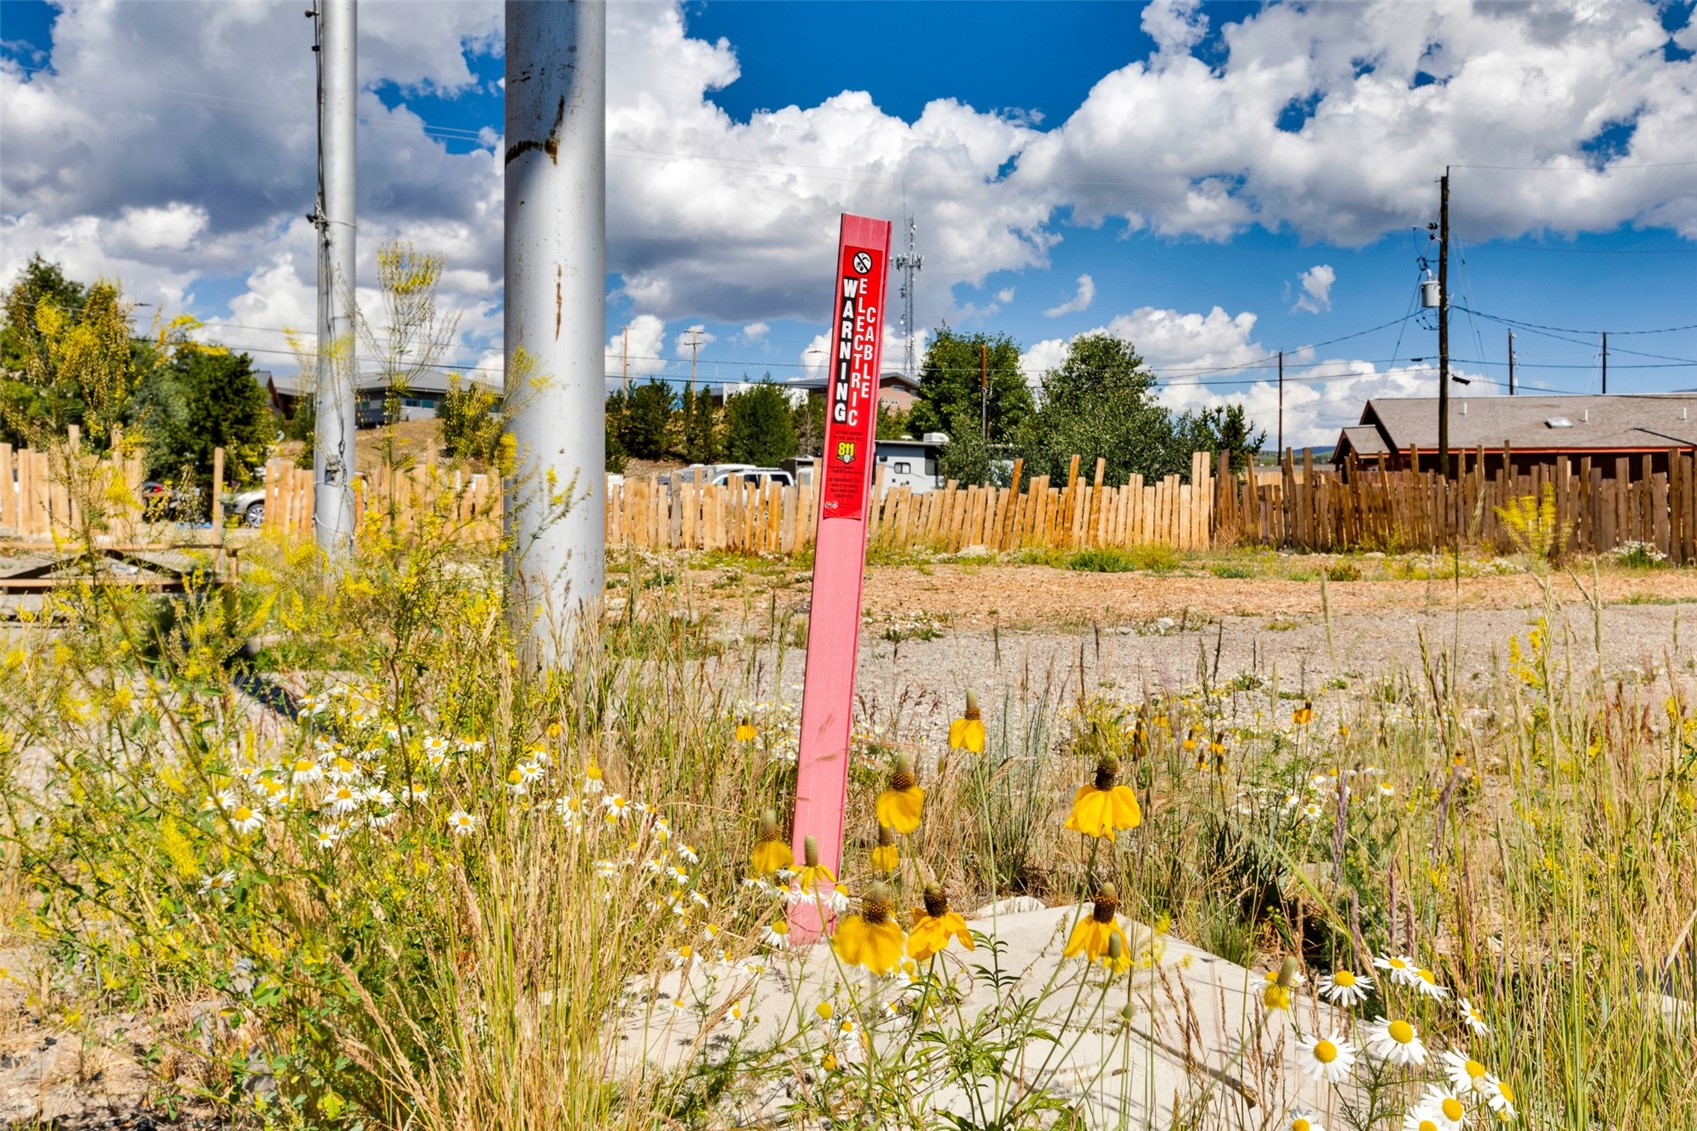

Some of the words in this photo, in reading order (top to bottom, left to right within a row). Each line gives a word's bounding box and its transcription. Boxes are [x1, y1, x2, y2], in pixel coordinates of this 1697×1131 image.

[834, 278, 858, 421] WARNING
[848, 278, 868, 426] ELECTRIC
[860, 306, 877, 399] CABLE
[838, 442, 855, 457] 811
